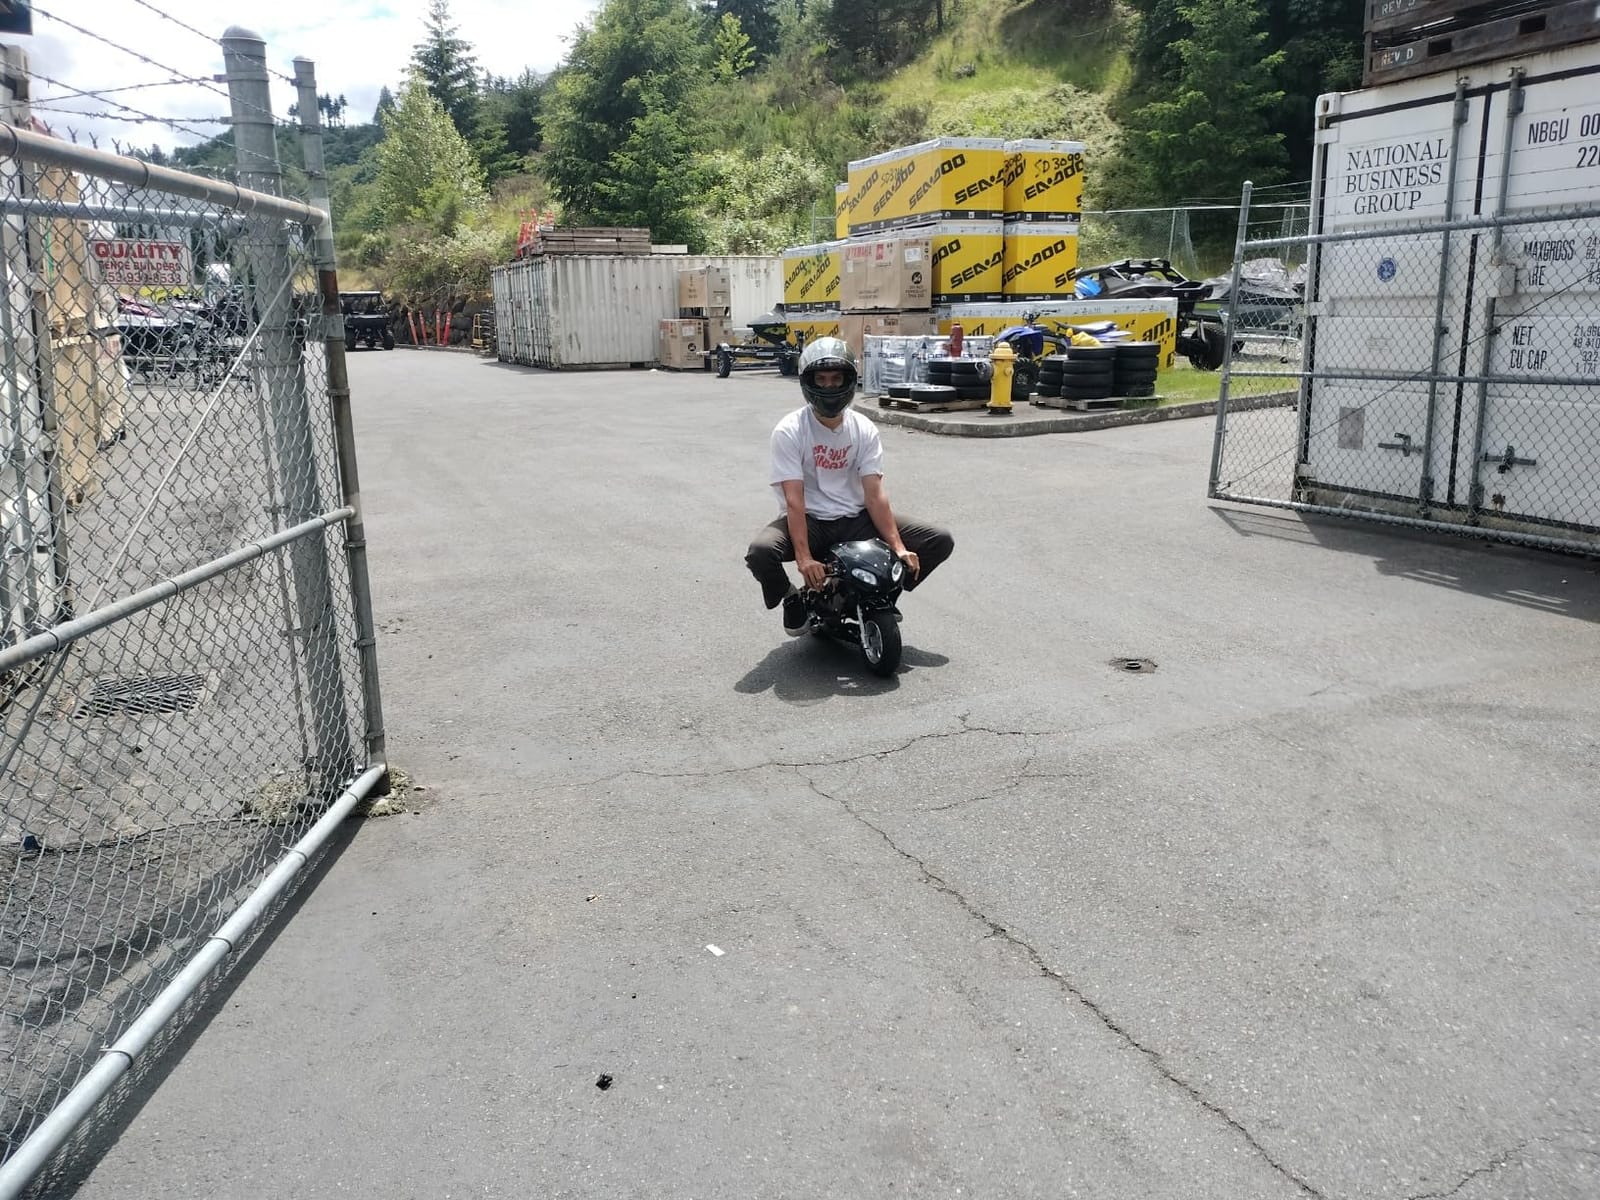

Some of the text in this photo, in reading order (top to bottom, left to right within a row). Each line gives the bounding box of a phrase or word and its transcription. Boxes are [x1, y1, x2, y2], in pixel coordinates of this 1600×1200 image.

[1407, 48, 1414, 60] D
[1528, 117, 1569, 145] NBGU
[1346, 139, 1449, 171] NATIONAL
[1576, 145, 1600, 169] 22
[1345, 162, 1442, 193] BUSINESS
[1354, 190, 1421, 215] GROUP
[95, 242, 180, 259] QUALITY
[1512, 325, 1535, 346] NET
